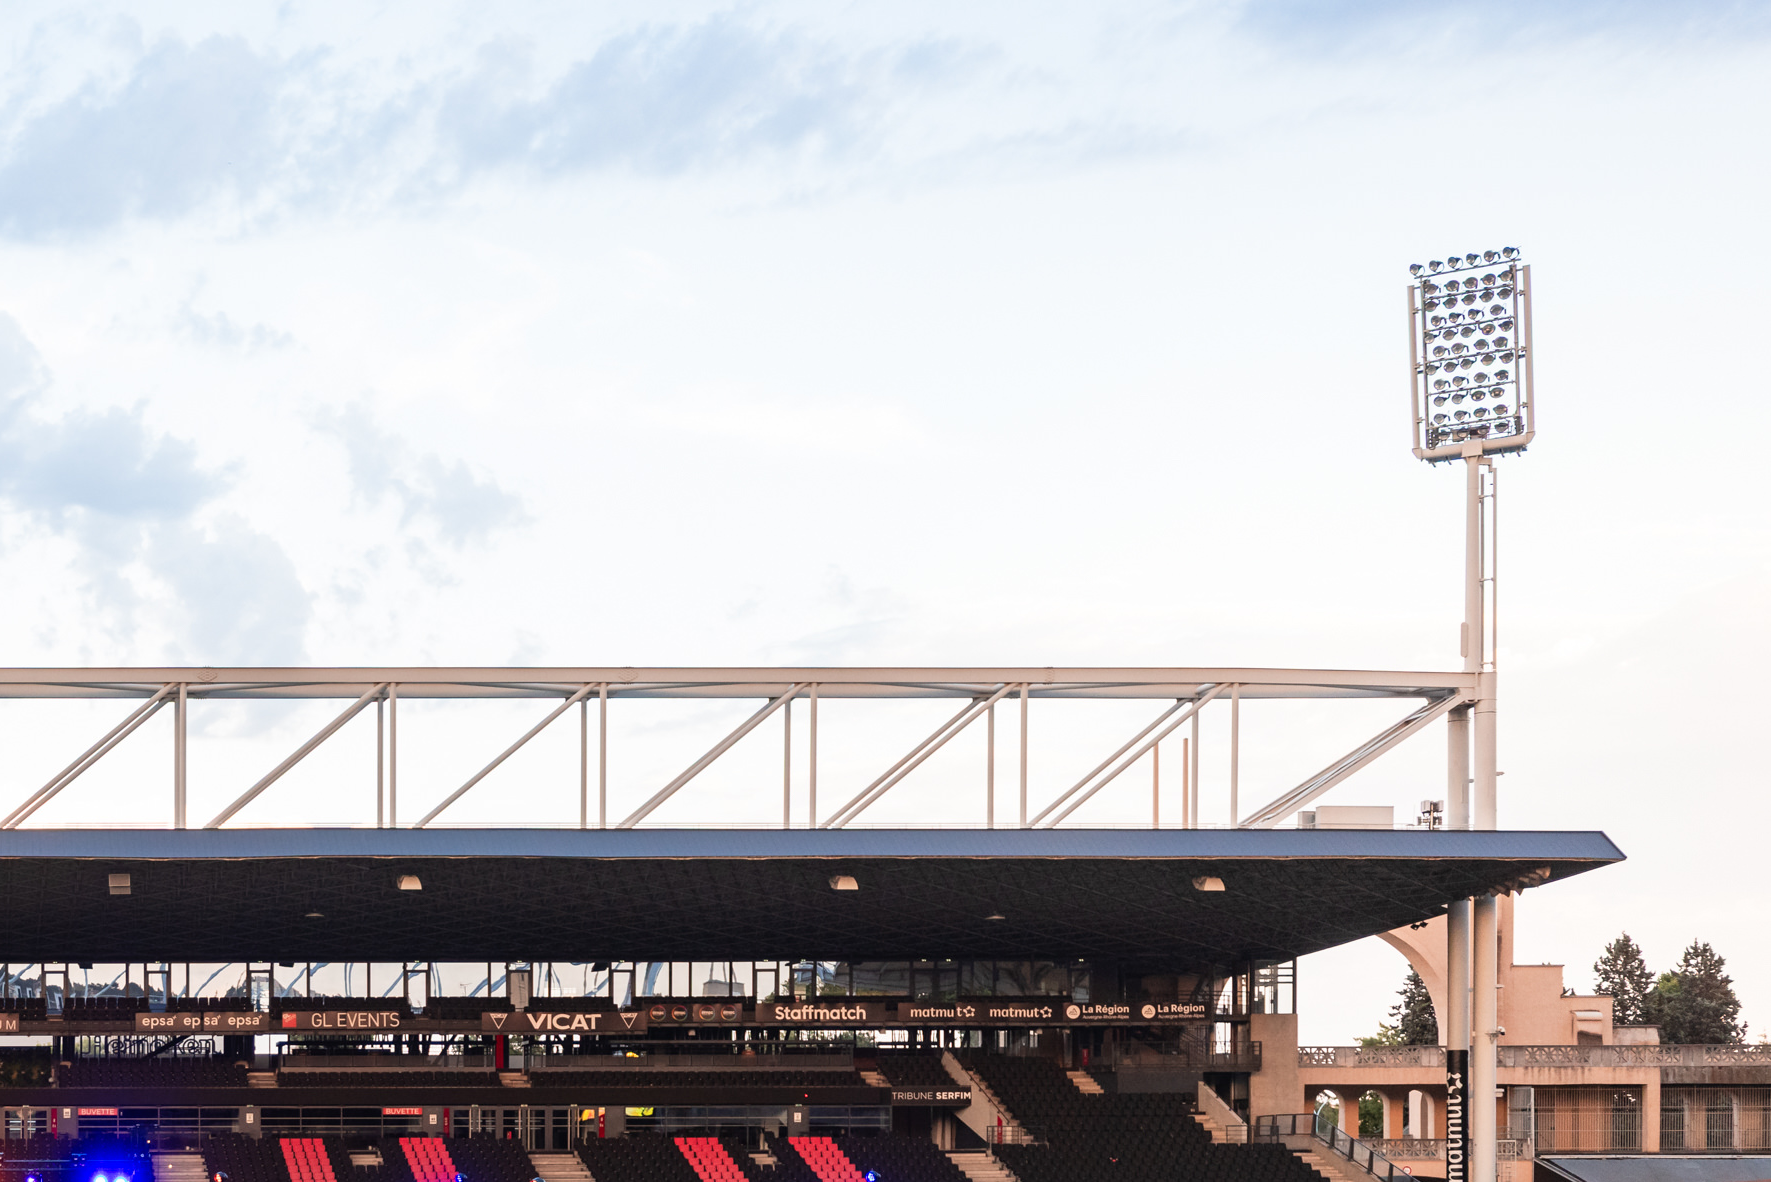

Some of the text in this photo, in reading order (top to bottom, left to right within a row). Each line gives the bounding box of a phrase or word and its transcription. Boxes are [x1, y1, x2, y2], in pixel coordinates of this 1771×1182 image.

[775, 1005, 866, 1020] Staffmatch
[910, 1006, 962, 1018] matmut
[989, 1007, 1040, 1018] matmut
[1082, 1004, 1130, 1015] La Région
[1157, 1003, 1205, 1014] La Région
[142, 1016, 174, 1029] epsa
[228, 1015, 260, 1028] epsa
[311, 1013, 333, 1027] GL
[337, 1012, 400, 1027] EVENTS
[527, 1013, 602, 1030] VICAT
[892, 1091, 971, 1100] TRIBUNE SERFIM
